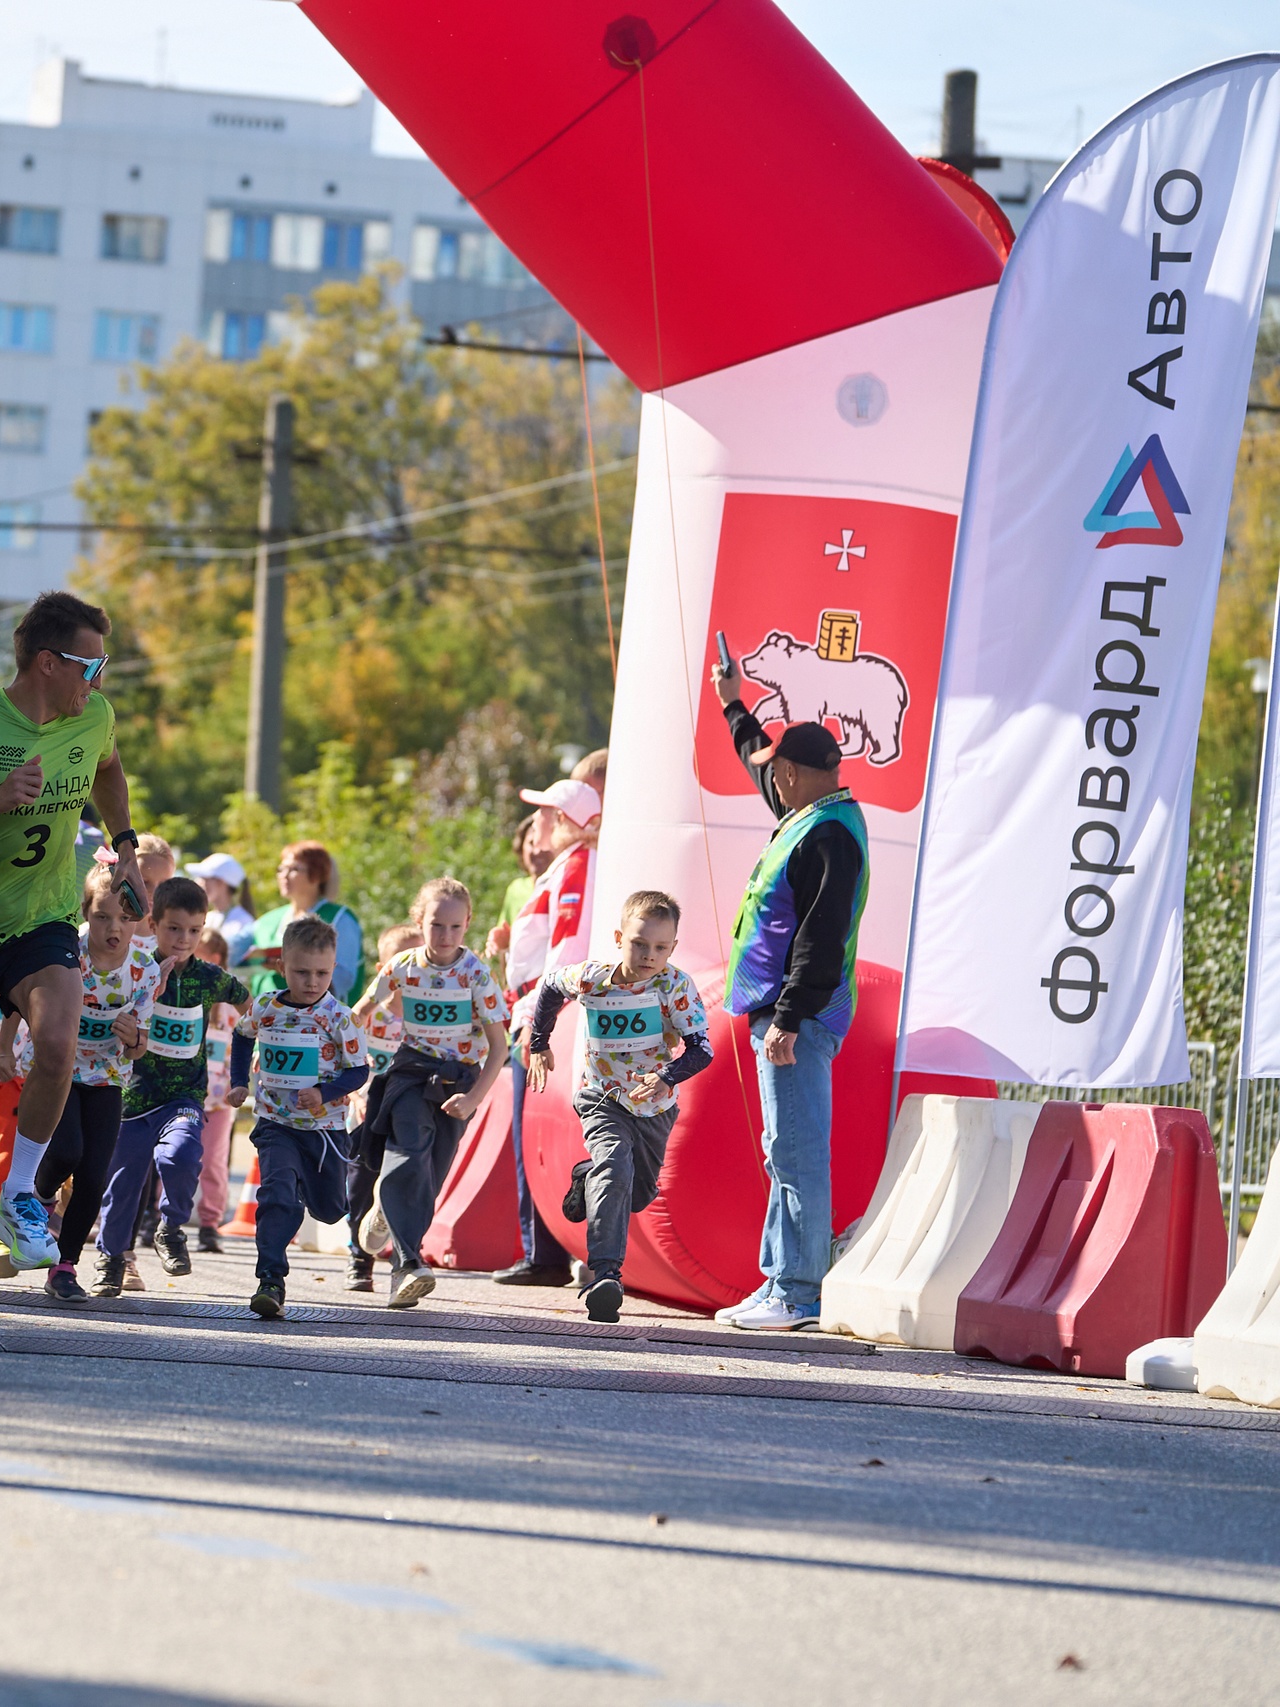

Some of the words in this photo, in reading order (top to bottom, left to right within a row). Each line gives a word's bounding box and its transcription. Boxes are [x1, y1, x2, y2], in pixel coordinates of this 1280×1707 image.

[1040, 575, 1167, 1024] Форвард
[10, 824, 51, 868] 3
[414, 1002, 458, 1023] 893
[597, 1012, 647, 1035] 996
[79, 1019, 115, 1039] 88
[153, 1019, 196, 1044] 585
[264, 1047, 304, 1072] 997
